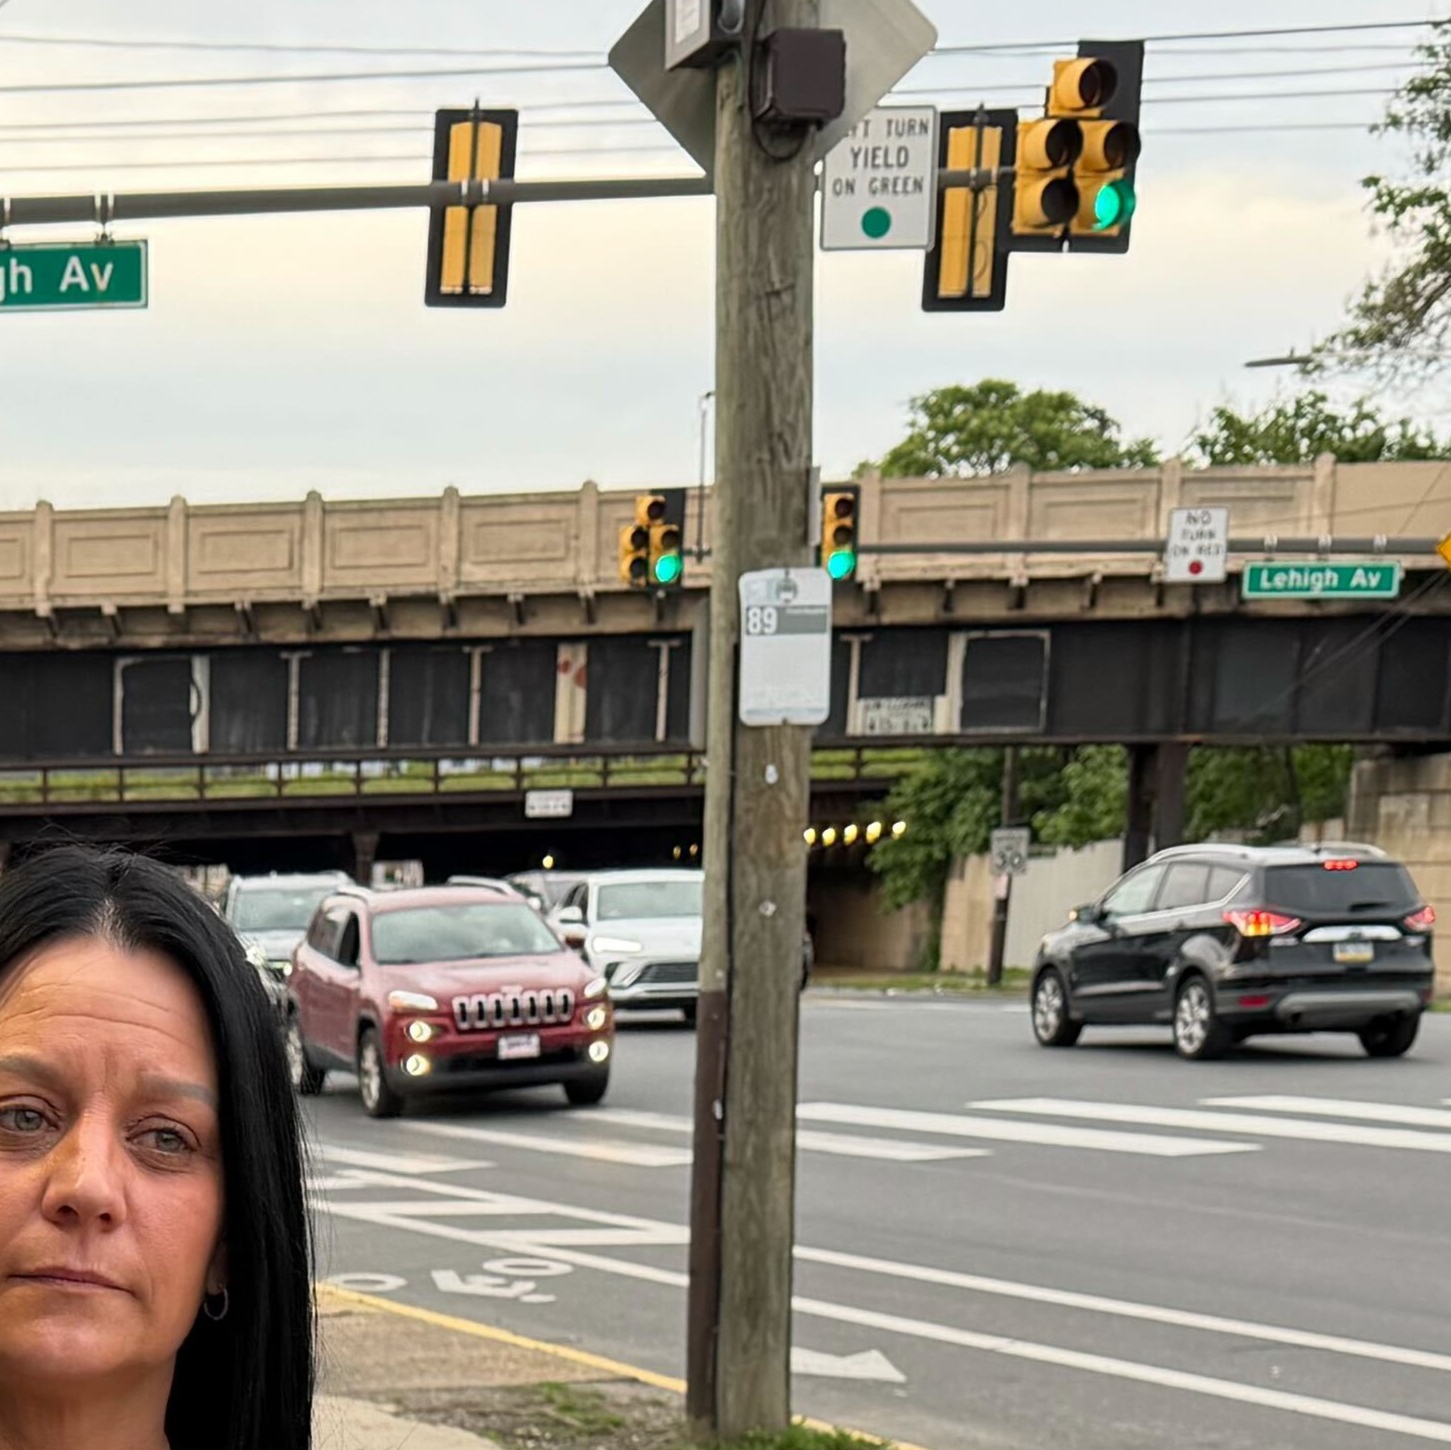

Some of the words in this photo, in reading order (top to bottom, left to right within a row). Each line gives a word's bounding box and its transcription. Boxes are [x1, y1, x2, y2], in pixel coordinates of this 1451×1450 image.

[886, 118, 929, 137] TURN
[850, 146, 909, 168] YIELD
[832, 178, 856, 196] ON
[868, 176, 924, 195] GREEN
[58, 256, 114, 293] Av
[1186, 510, 1212, 525] NO
[1259, 568, 1339, 591] Lehigh
[1350, 570, 1381, 588] Av
[748, 606, 778, 635] 89
